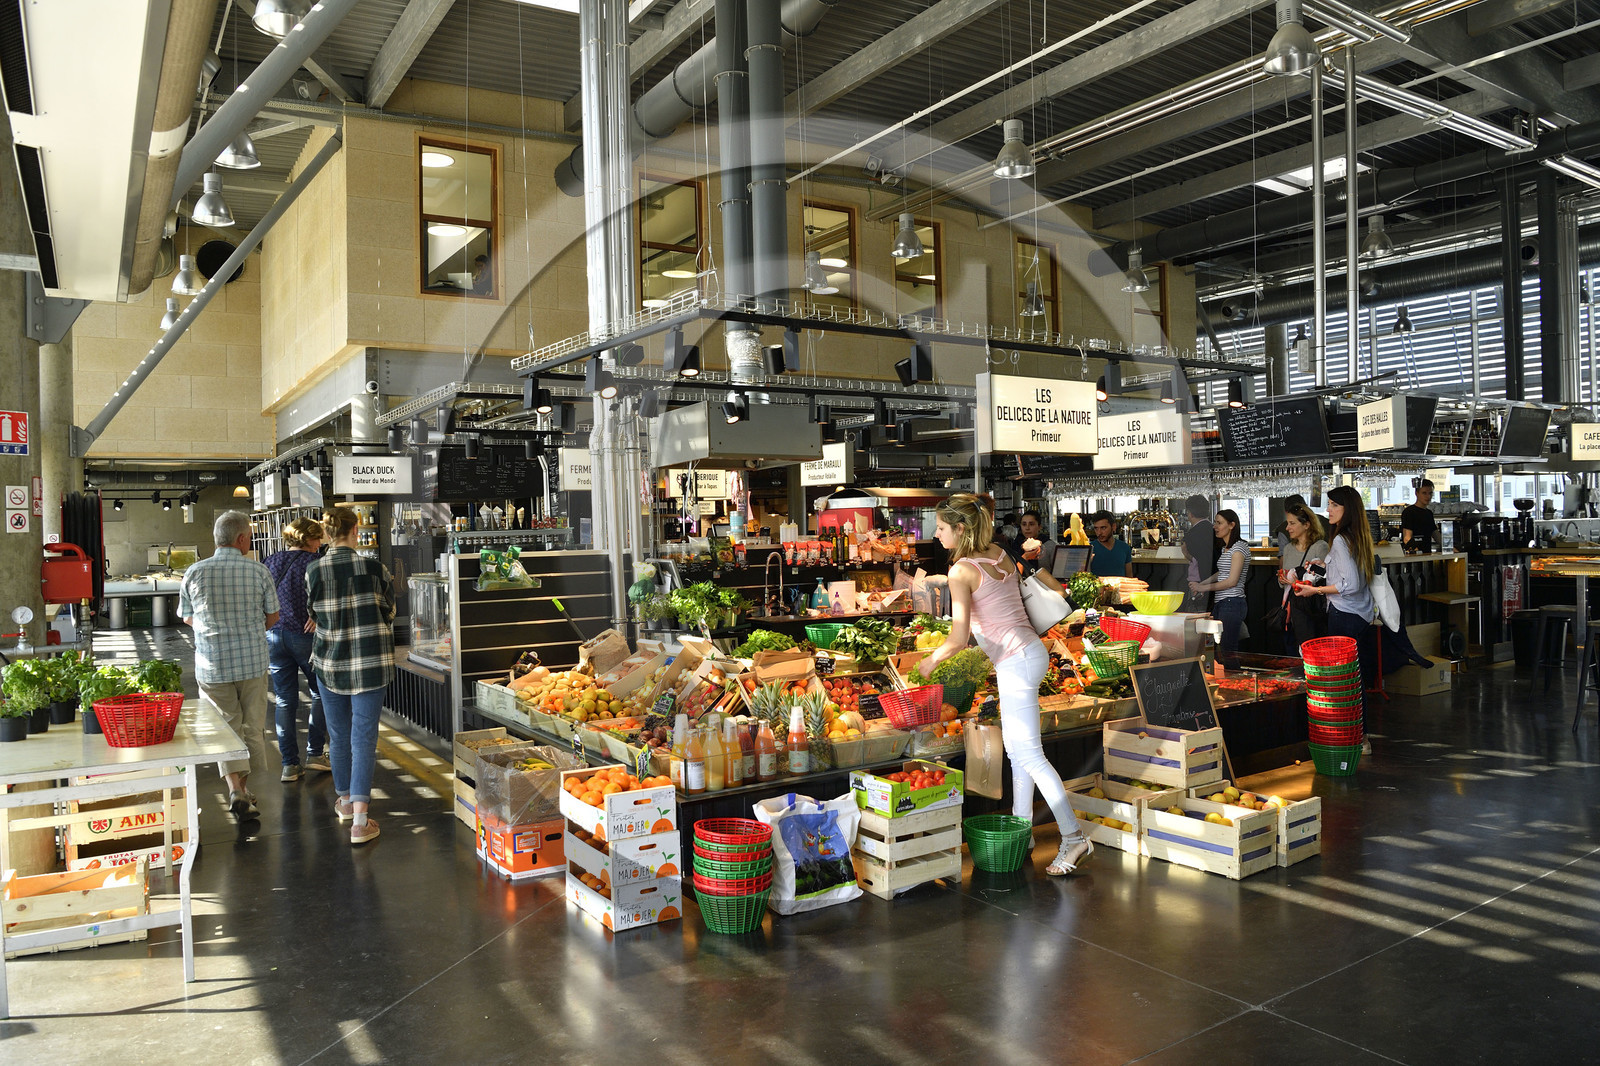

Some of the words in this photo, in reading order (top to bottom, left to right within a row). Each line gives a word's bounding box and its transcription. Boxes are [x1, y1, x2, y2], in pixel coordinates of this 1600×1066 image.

[1035, 388, 1052, 404] LES
[997, 405, 1033, 422] DELICES
[1035, 408, 1047, 423] DE
[1048, 409, 1059, 424] LA
[1061, 410, 1092, 425] NATURE
[1127, 420, 1141, 432] LES
[1031, 429, 1061, 443] Primeur
[1098, 436, 1125, 449] DELICES
[1127, 435, 1136, 446] DE
[1137, 434, 1147, 445] LA
[1148, 431, 1177, 444] NATURE
[1584, 432, 1600, 441] CAFE
[1123, 451, 1149, 460] Primeur
[352, 466, 375, 475] BLACK
[376, 466, 395, 475] DUCK
[570, 464, 592, 474] FERME
[804, 461, 817, 471] FERME
[818, 460, 823, 470] DE
[103, 852, 134, 860] FRUTAS
